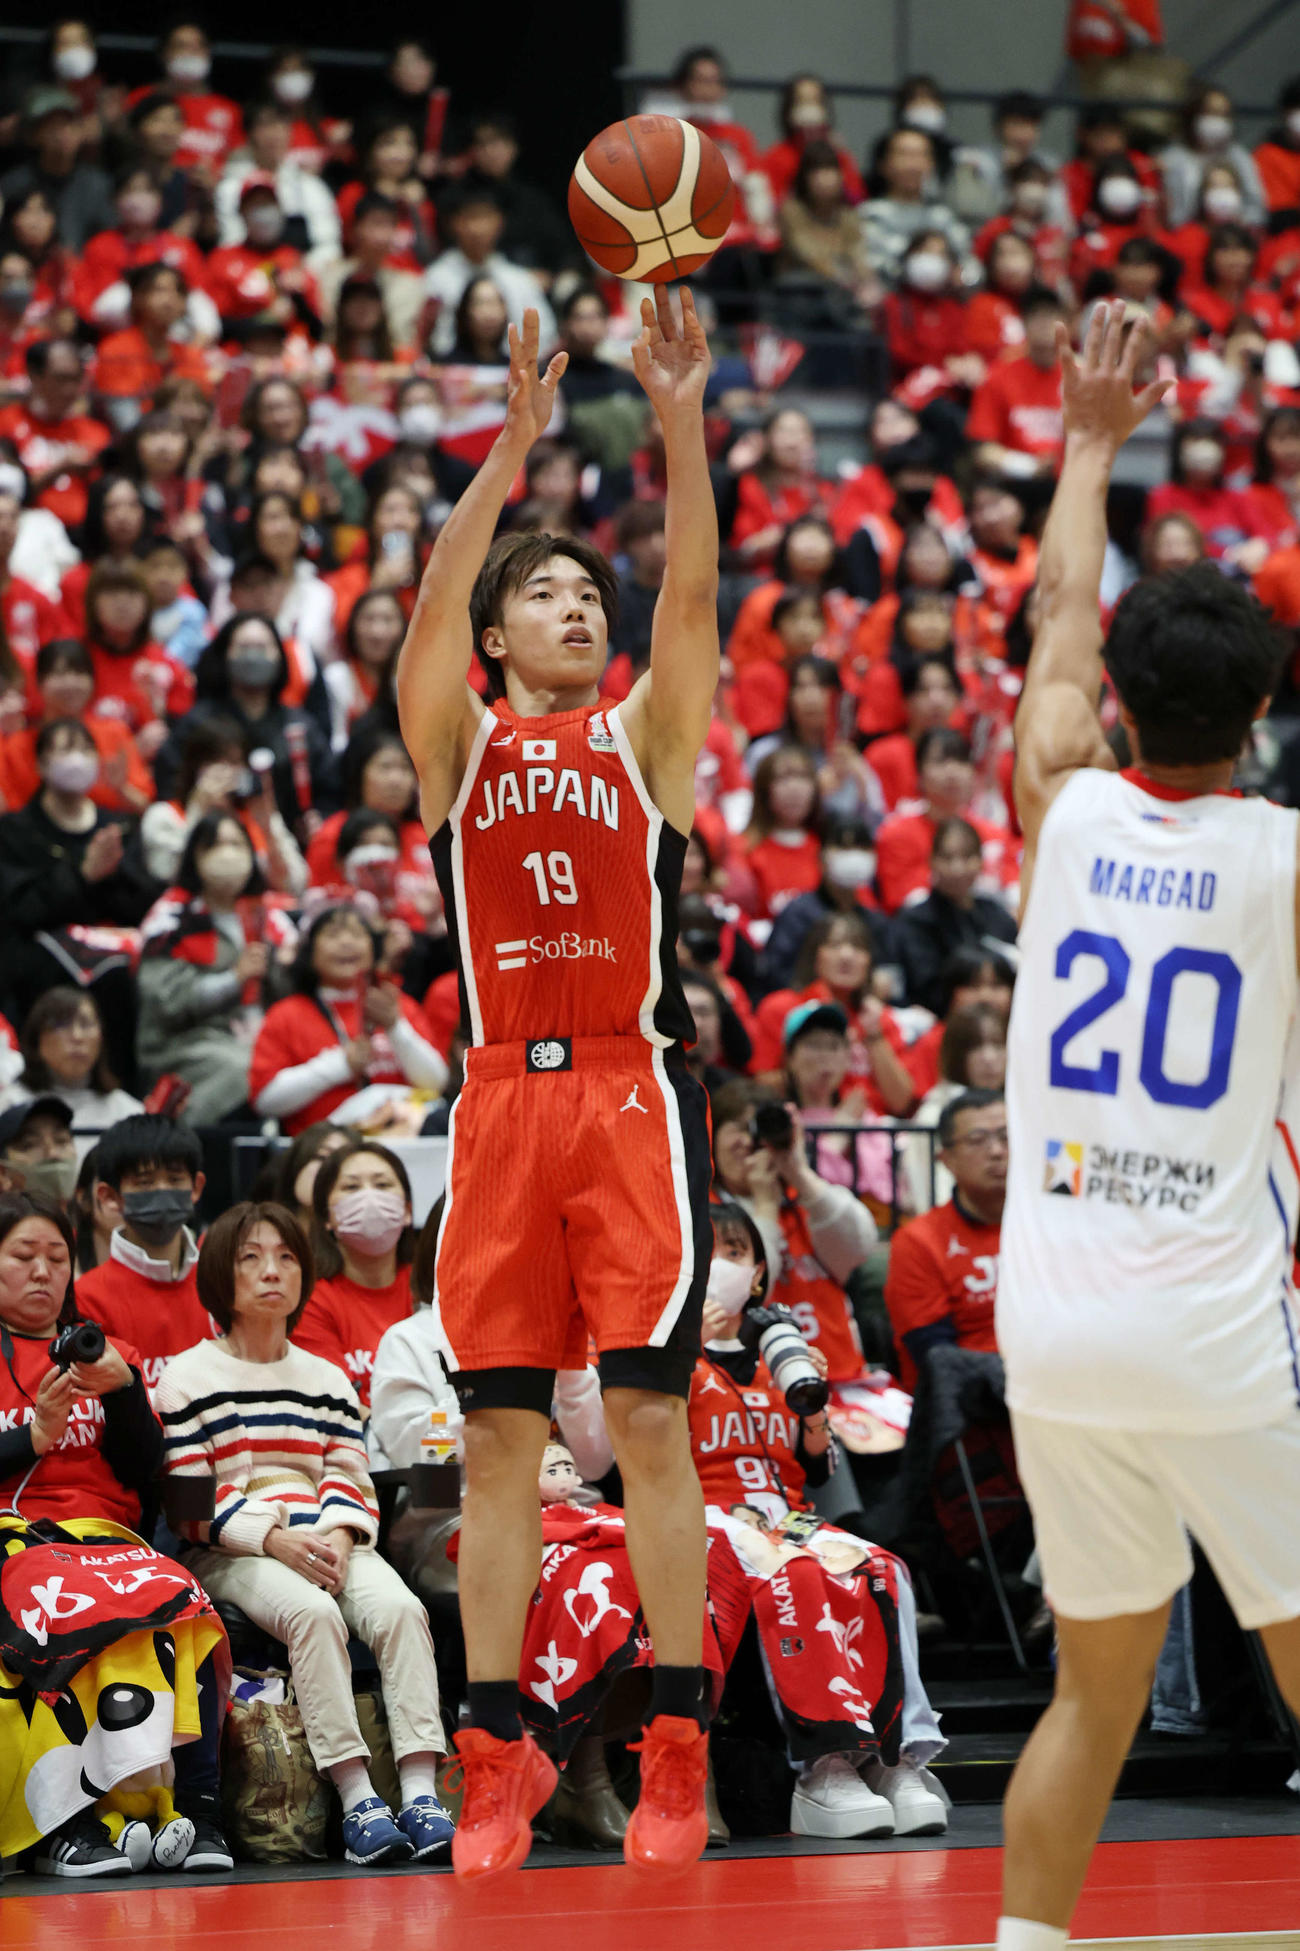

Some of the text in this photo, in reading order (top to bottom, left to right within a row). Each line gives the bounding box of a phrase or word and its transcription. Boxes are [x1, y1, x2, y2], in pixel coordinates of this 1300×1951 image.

[475, 766, 619, 831] JAPAN
[521, 850, 579, 906] 19
[1089, 857, 1217, 912] MARGAD
[1049, 928, 1242, 1111] 20
[1086, 1175, 1202, 1214] РЕСУРС
[1089, 1146, 1216, 1190] ЭНЕРЖИ
